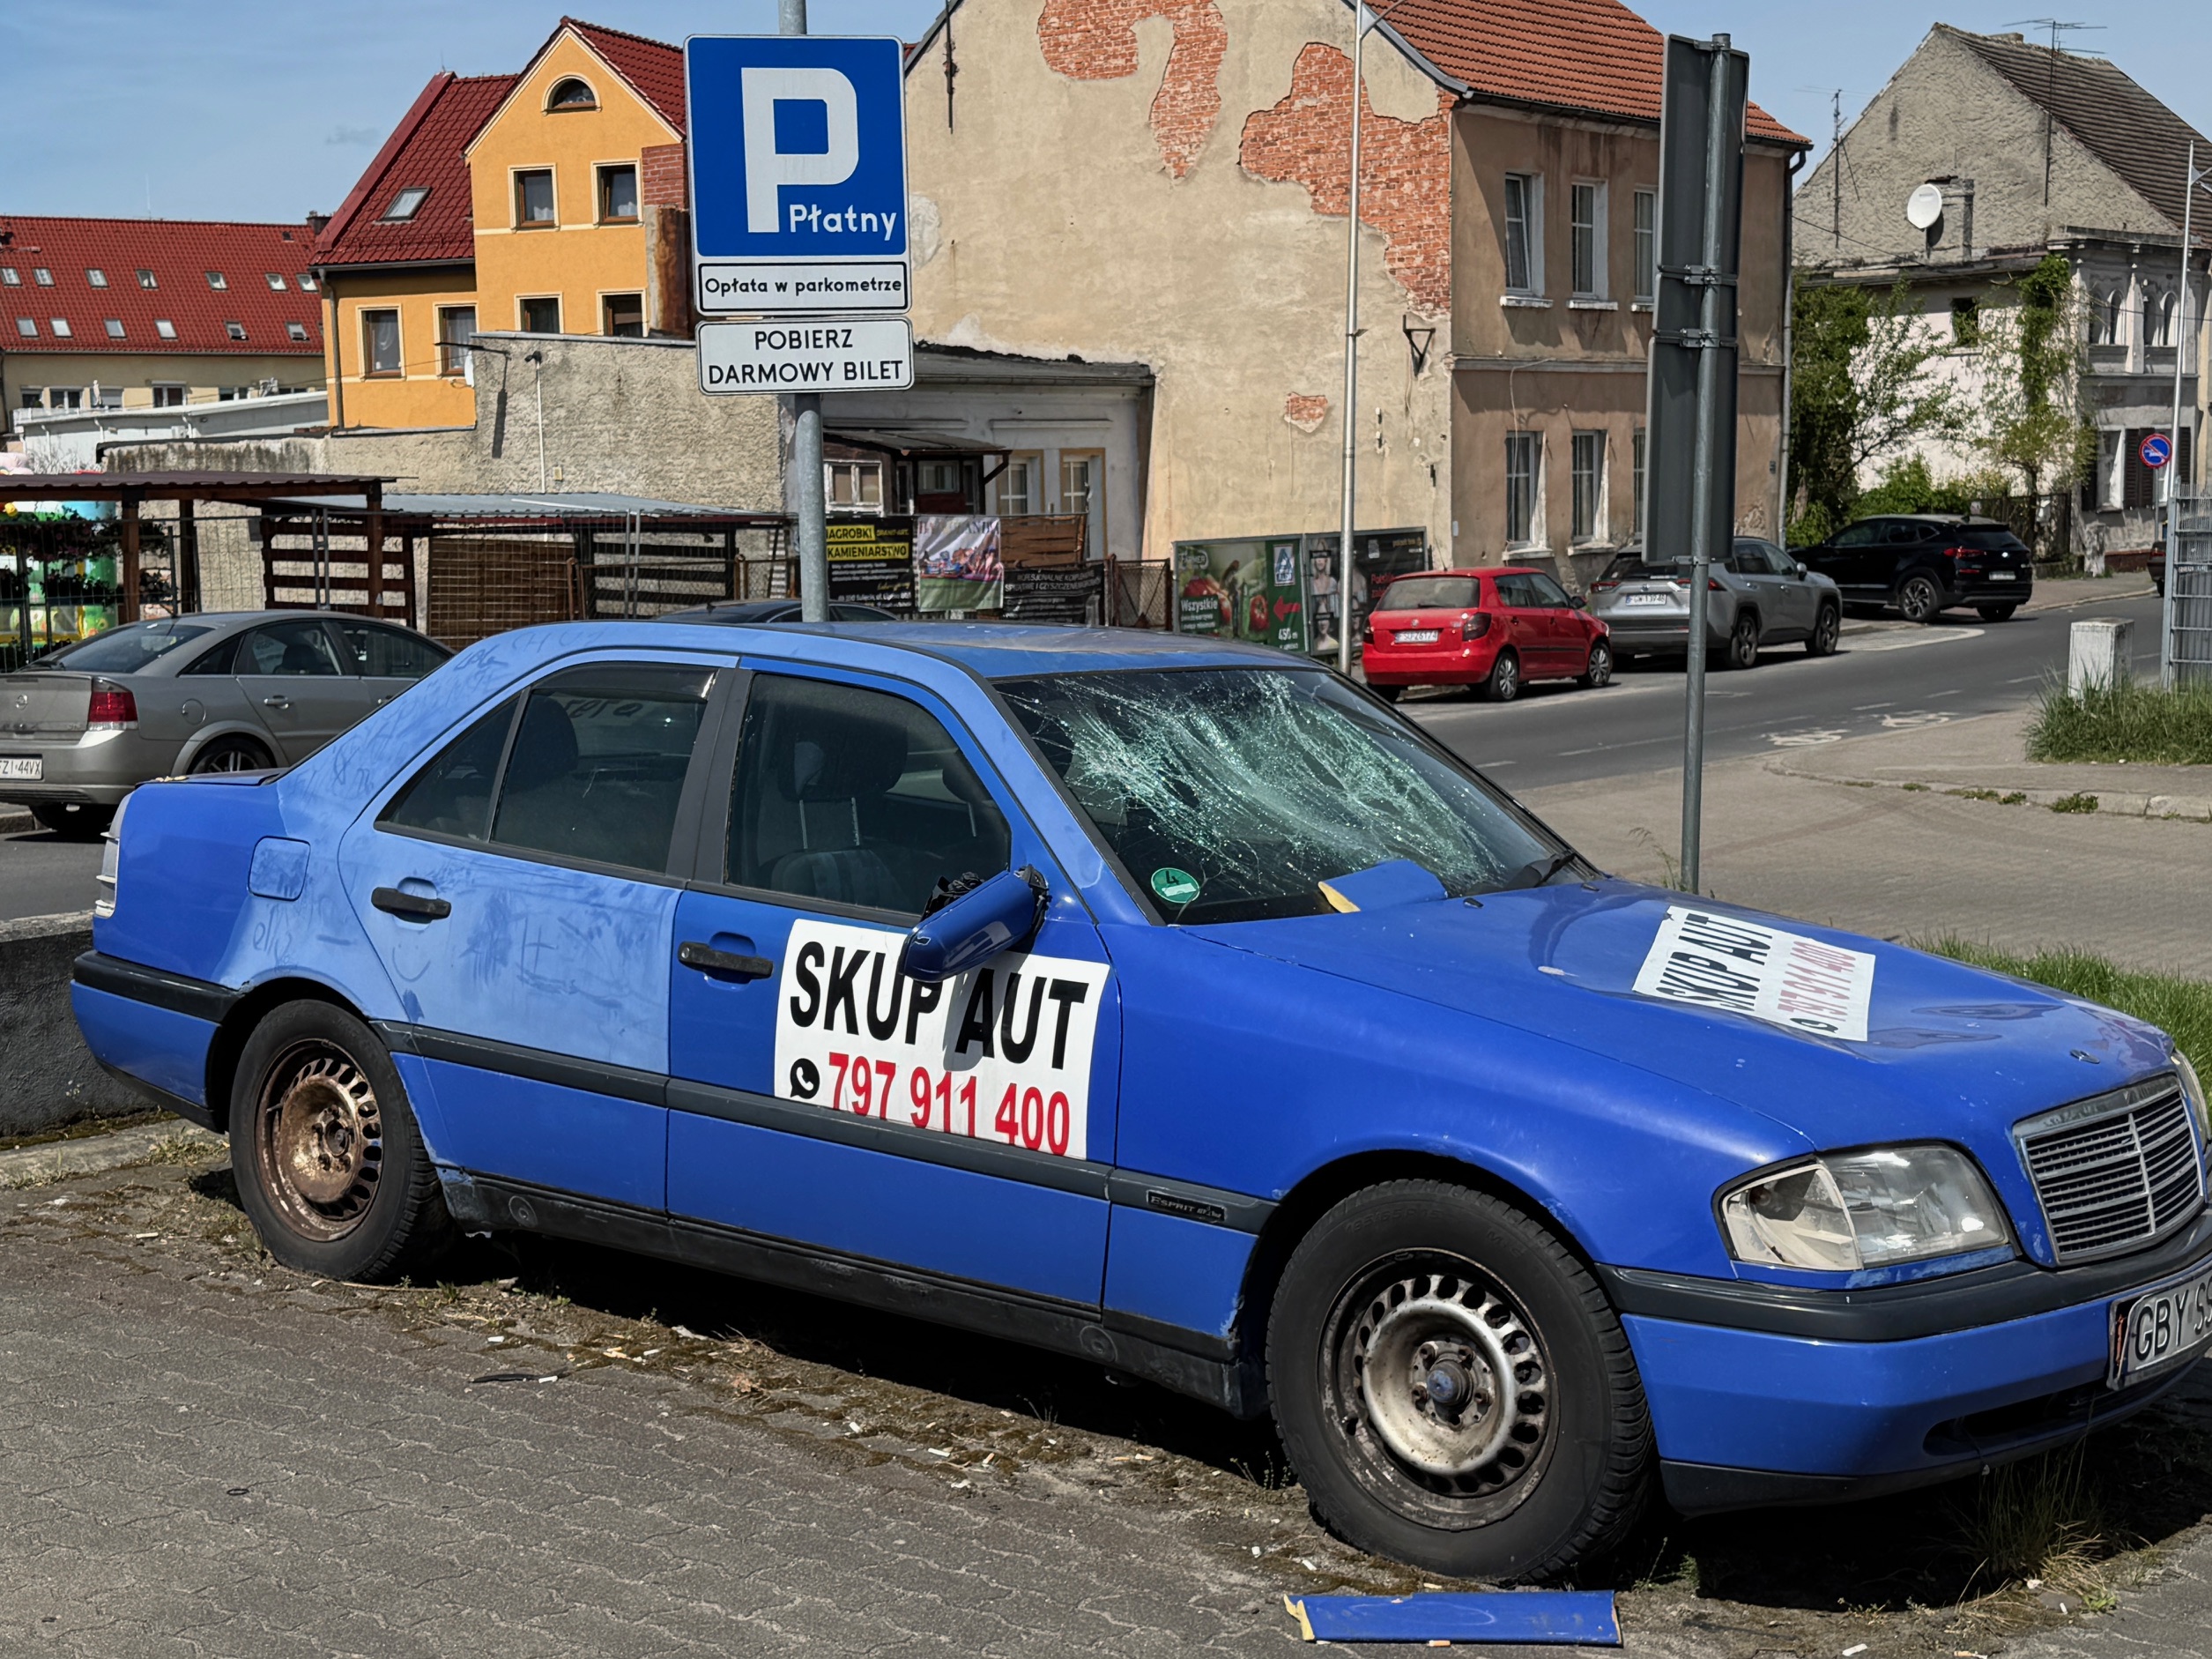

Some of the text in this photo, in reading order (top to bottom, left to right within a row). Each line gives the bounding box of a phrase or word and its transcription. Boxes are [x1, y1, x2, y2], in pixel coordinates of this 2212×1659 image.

[741, 67, 859, 233] P
[790, 204, 897, 241] Płatny
[705, 276, 902, 298] Opłata w parkometrze
[754, 329, 853, 350] POBIERZ
[709, 360, 903, 384] DARMOWY BILET
[828, 545, 907, 558] KAMIENIARSTWO
[1181, 598, 1218, 614] Wszystkie
[18, 760, 41, 775] 44VX
[1656, 913, 1773, 1012] SKUP AUT
[790, 941, 1089, 1071] SKUP AUT
[828, 1051, 1070, 1156] 797 911 400
[2134, 1289, 2189, 1362] GBY
